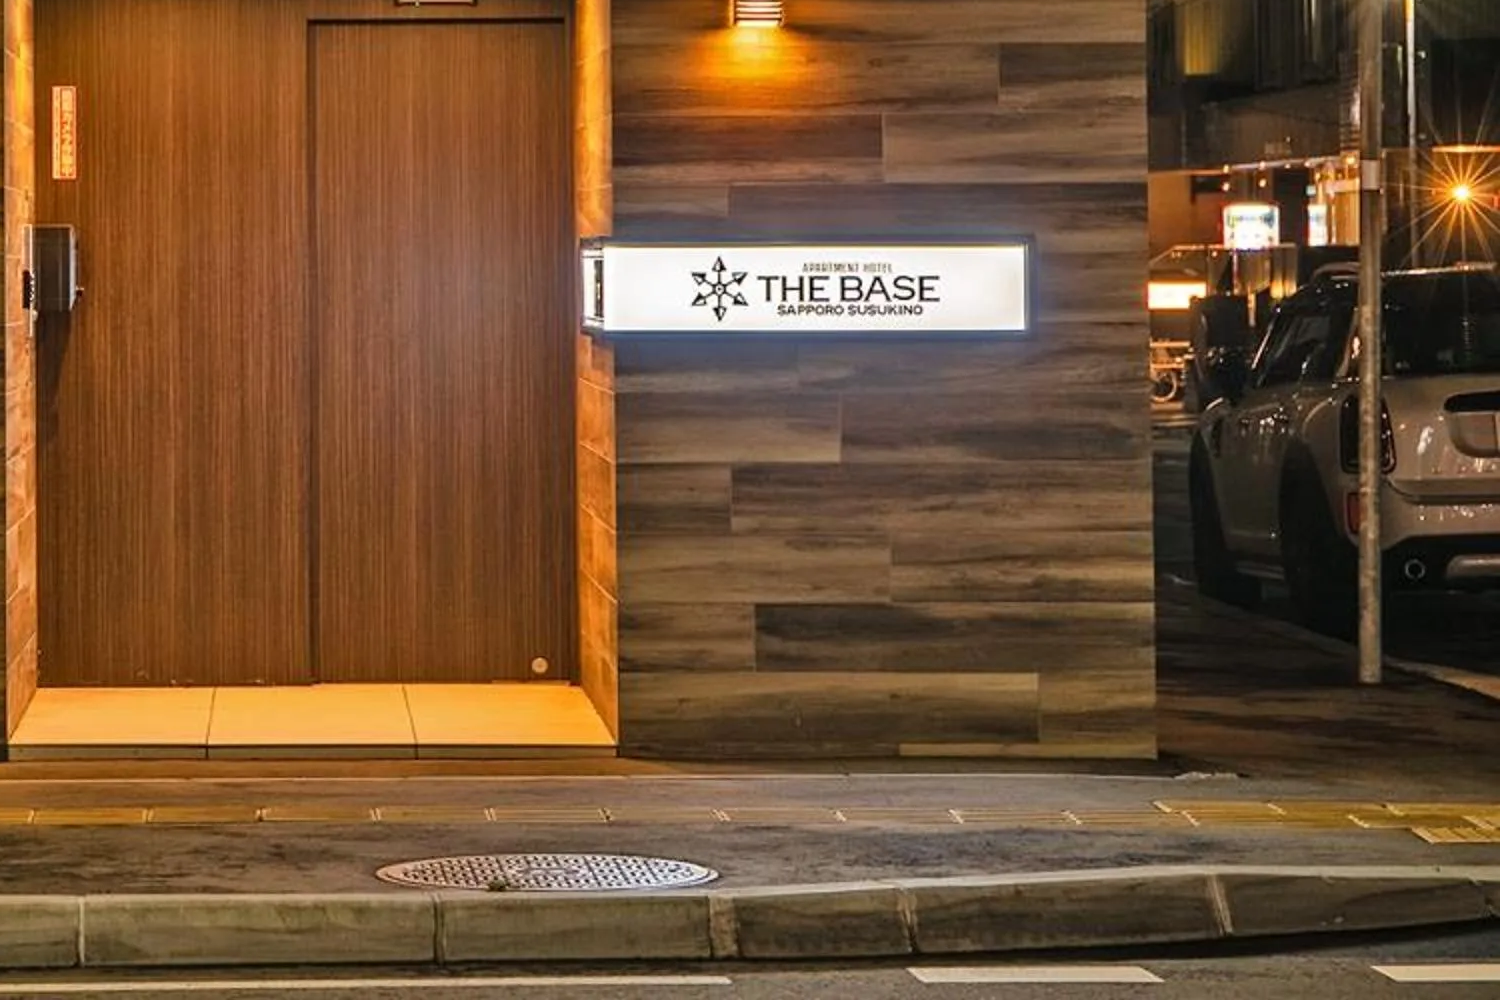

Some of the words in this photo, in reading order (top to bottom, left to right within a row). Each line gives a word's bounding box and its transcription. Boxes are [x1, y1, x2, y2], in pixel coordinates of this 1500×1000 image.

[802, 262, 859, 273] APARTMENT
[863, 262, 893, 273] HOTEL
[757, 275, 830, 302] THE
[840, 275, 940, 302] BASE
[777, 304, 844, 316] SAPPORO
[847, 304, 923, 316] SUSUKINO
